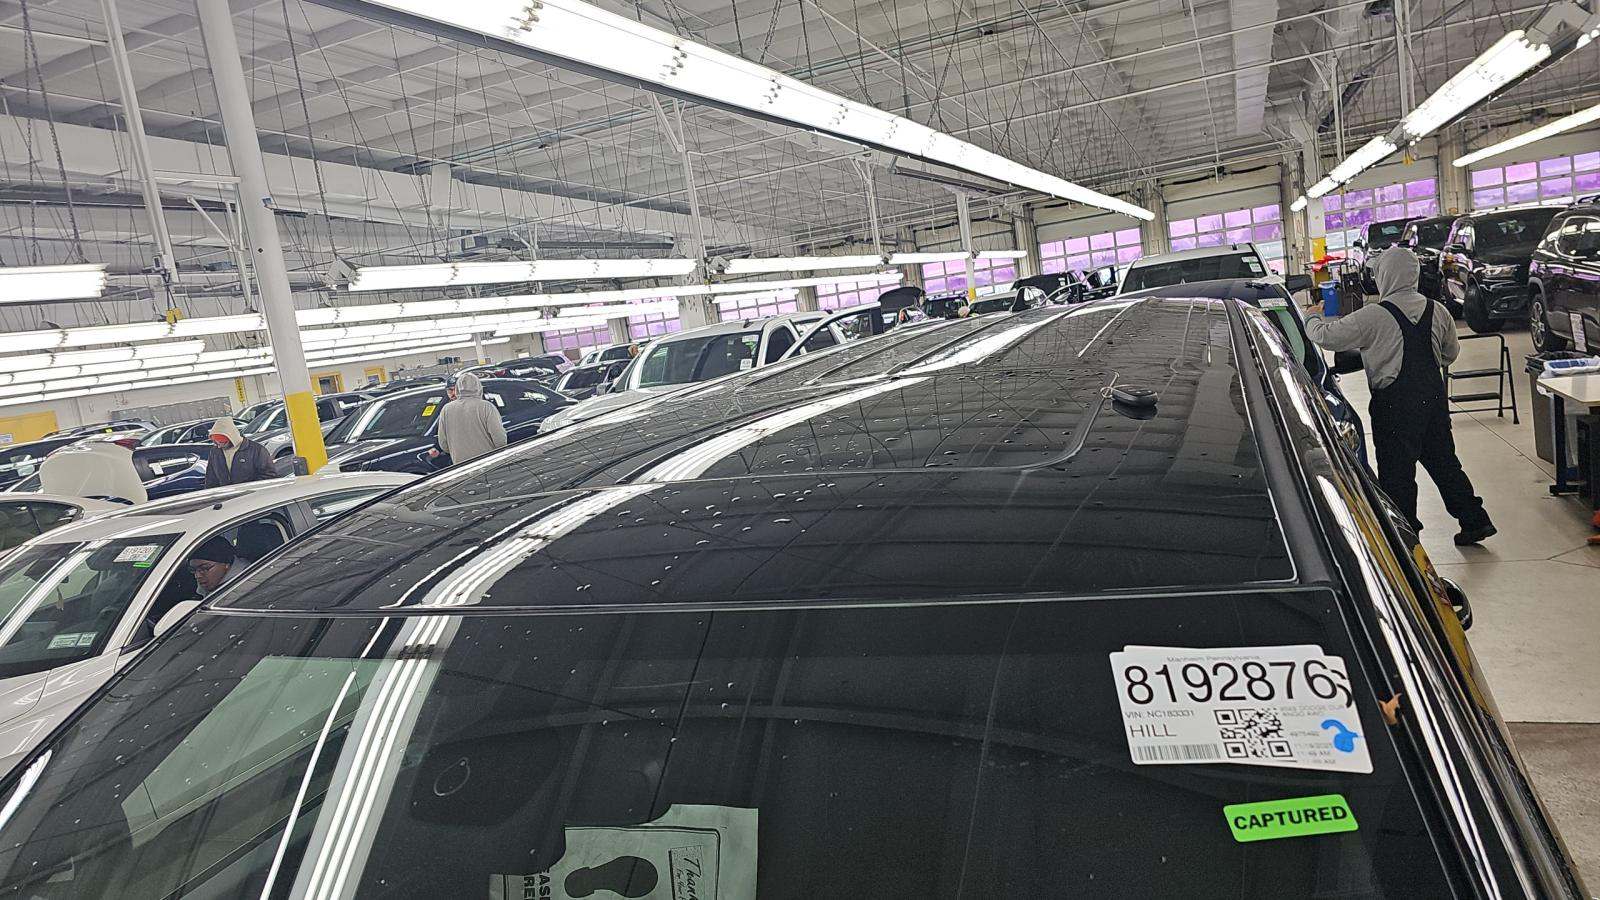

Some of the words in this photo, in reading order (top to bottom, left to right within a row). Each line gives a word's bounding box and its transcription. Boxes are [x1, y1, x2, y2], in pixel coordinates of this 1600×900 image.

[1124, 659, 1338, 705] 8192876
[1130, 723, 1177, 738] HILL
[1234, 805, 1348, 831] CAPTURED
